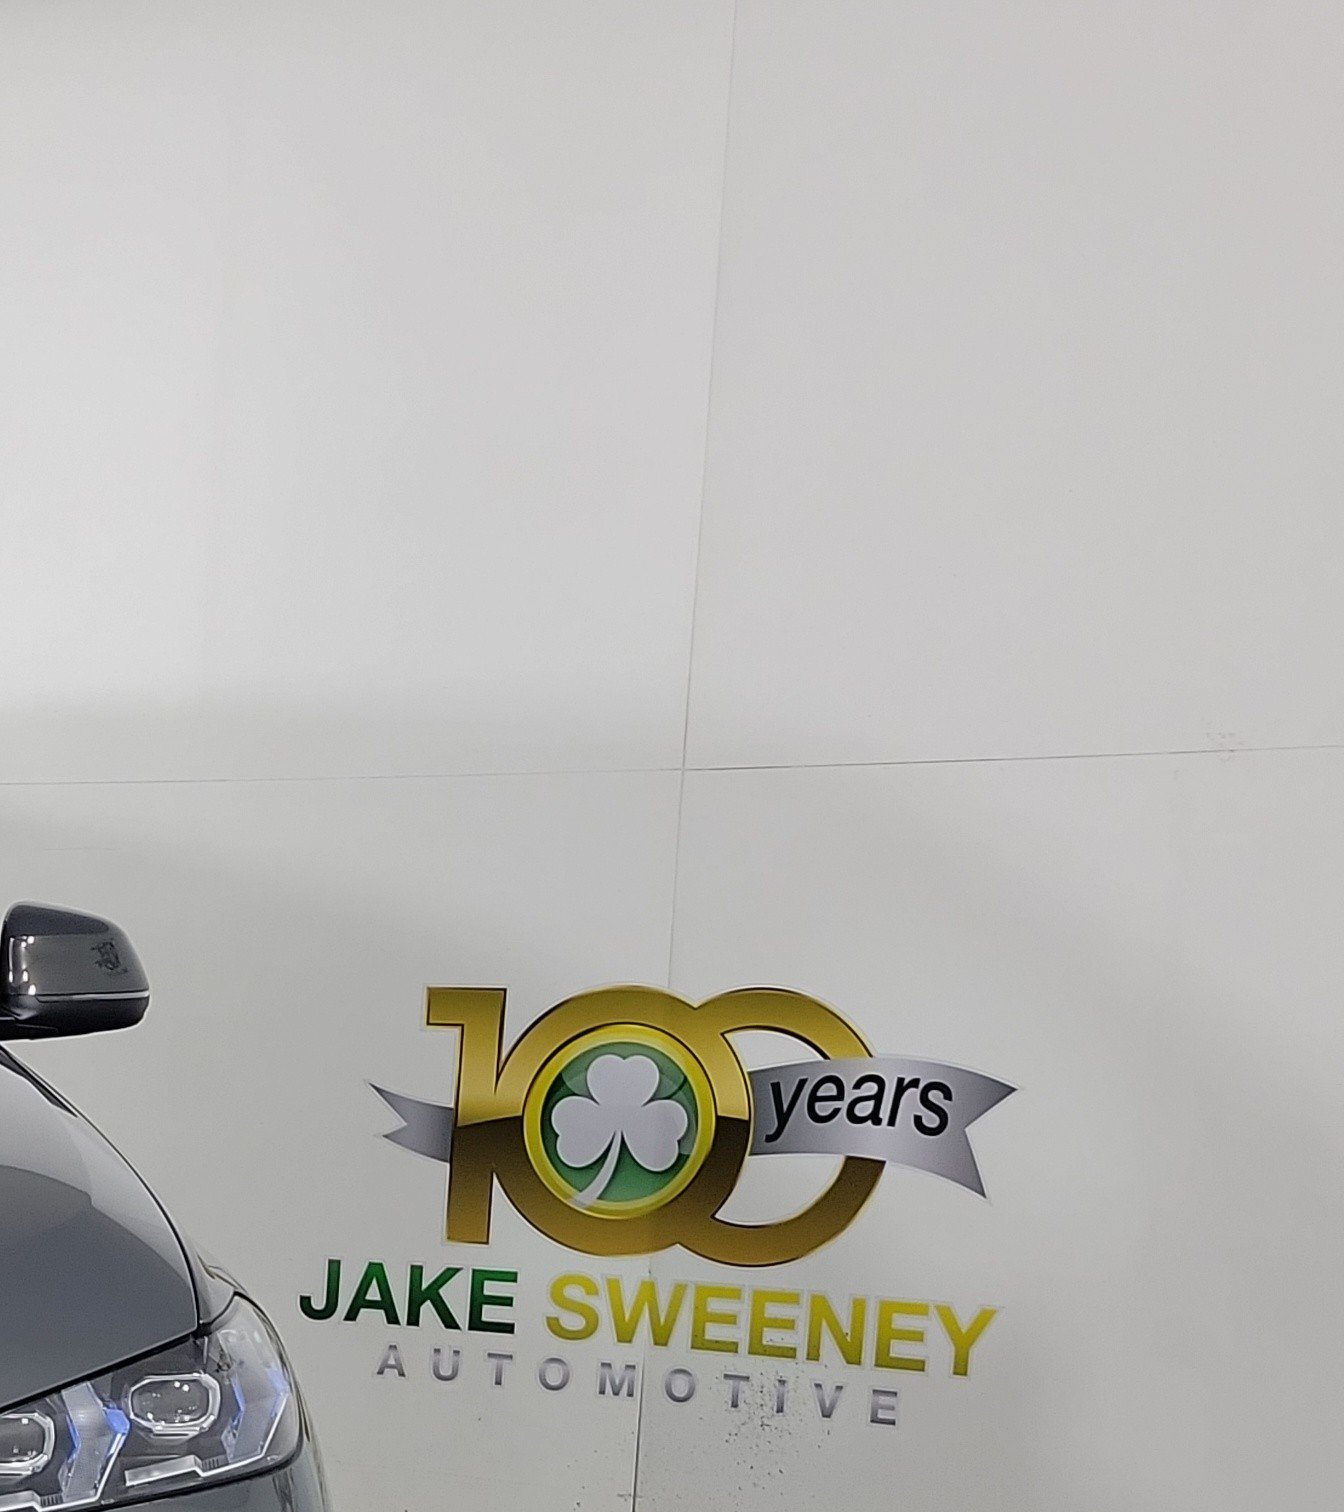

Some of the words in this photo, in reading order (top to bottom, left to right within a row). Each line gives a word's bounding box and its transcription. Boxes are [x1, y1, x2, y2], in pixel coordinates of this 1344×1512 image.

[426, 984, 887, 1268] 100
[763, 1072, 954, 1143] years
[299, 1258, 519, 1334] JAKE
[544, 1274, 998, 1377] SWEENEY
[376, 1344, 899, 1426] AUTOMOTIVE
